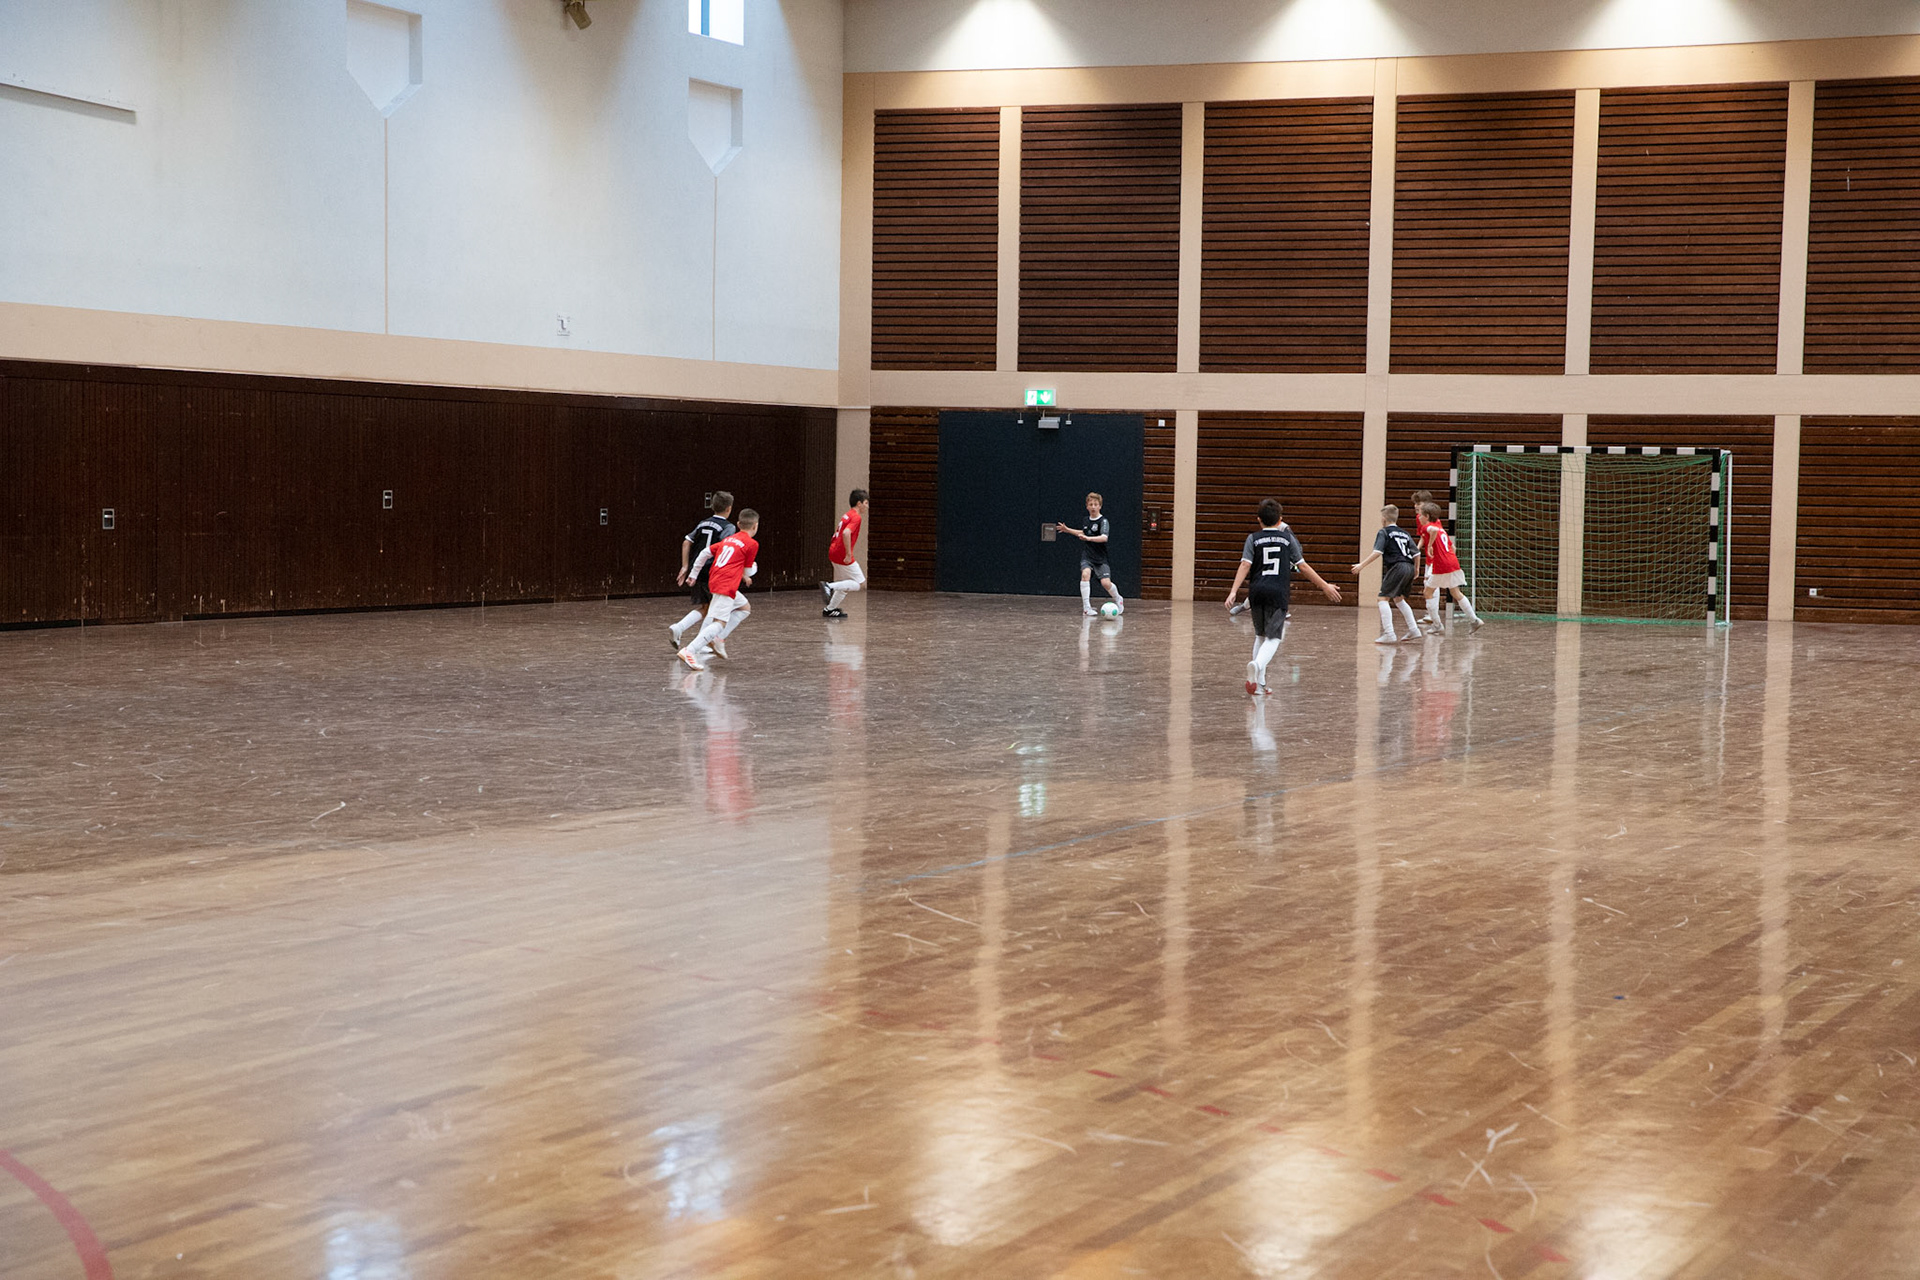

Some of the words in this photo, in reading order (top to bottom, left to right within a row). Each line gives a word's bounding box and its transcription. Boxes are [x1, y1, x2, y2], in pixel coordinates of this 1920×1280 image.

[702, 529, 713, 548] 7
[715, 545, 735, 568] 10
[1261, 546, 1281, 576] 5
